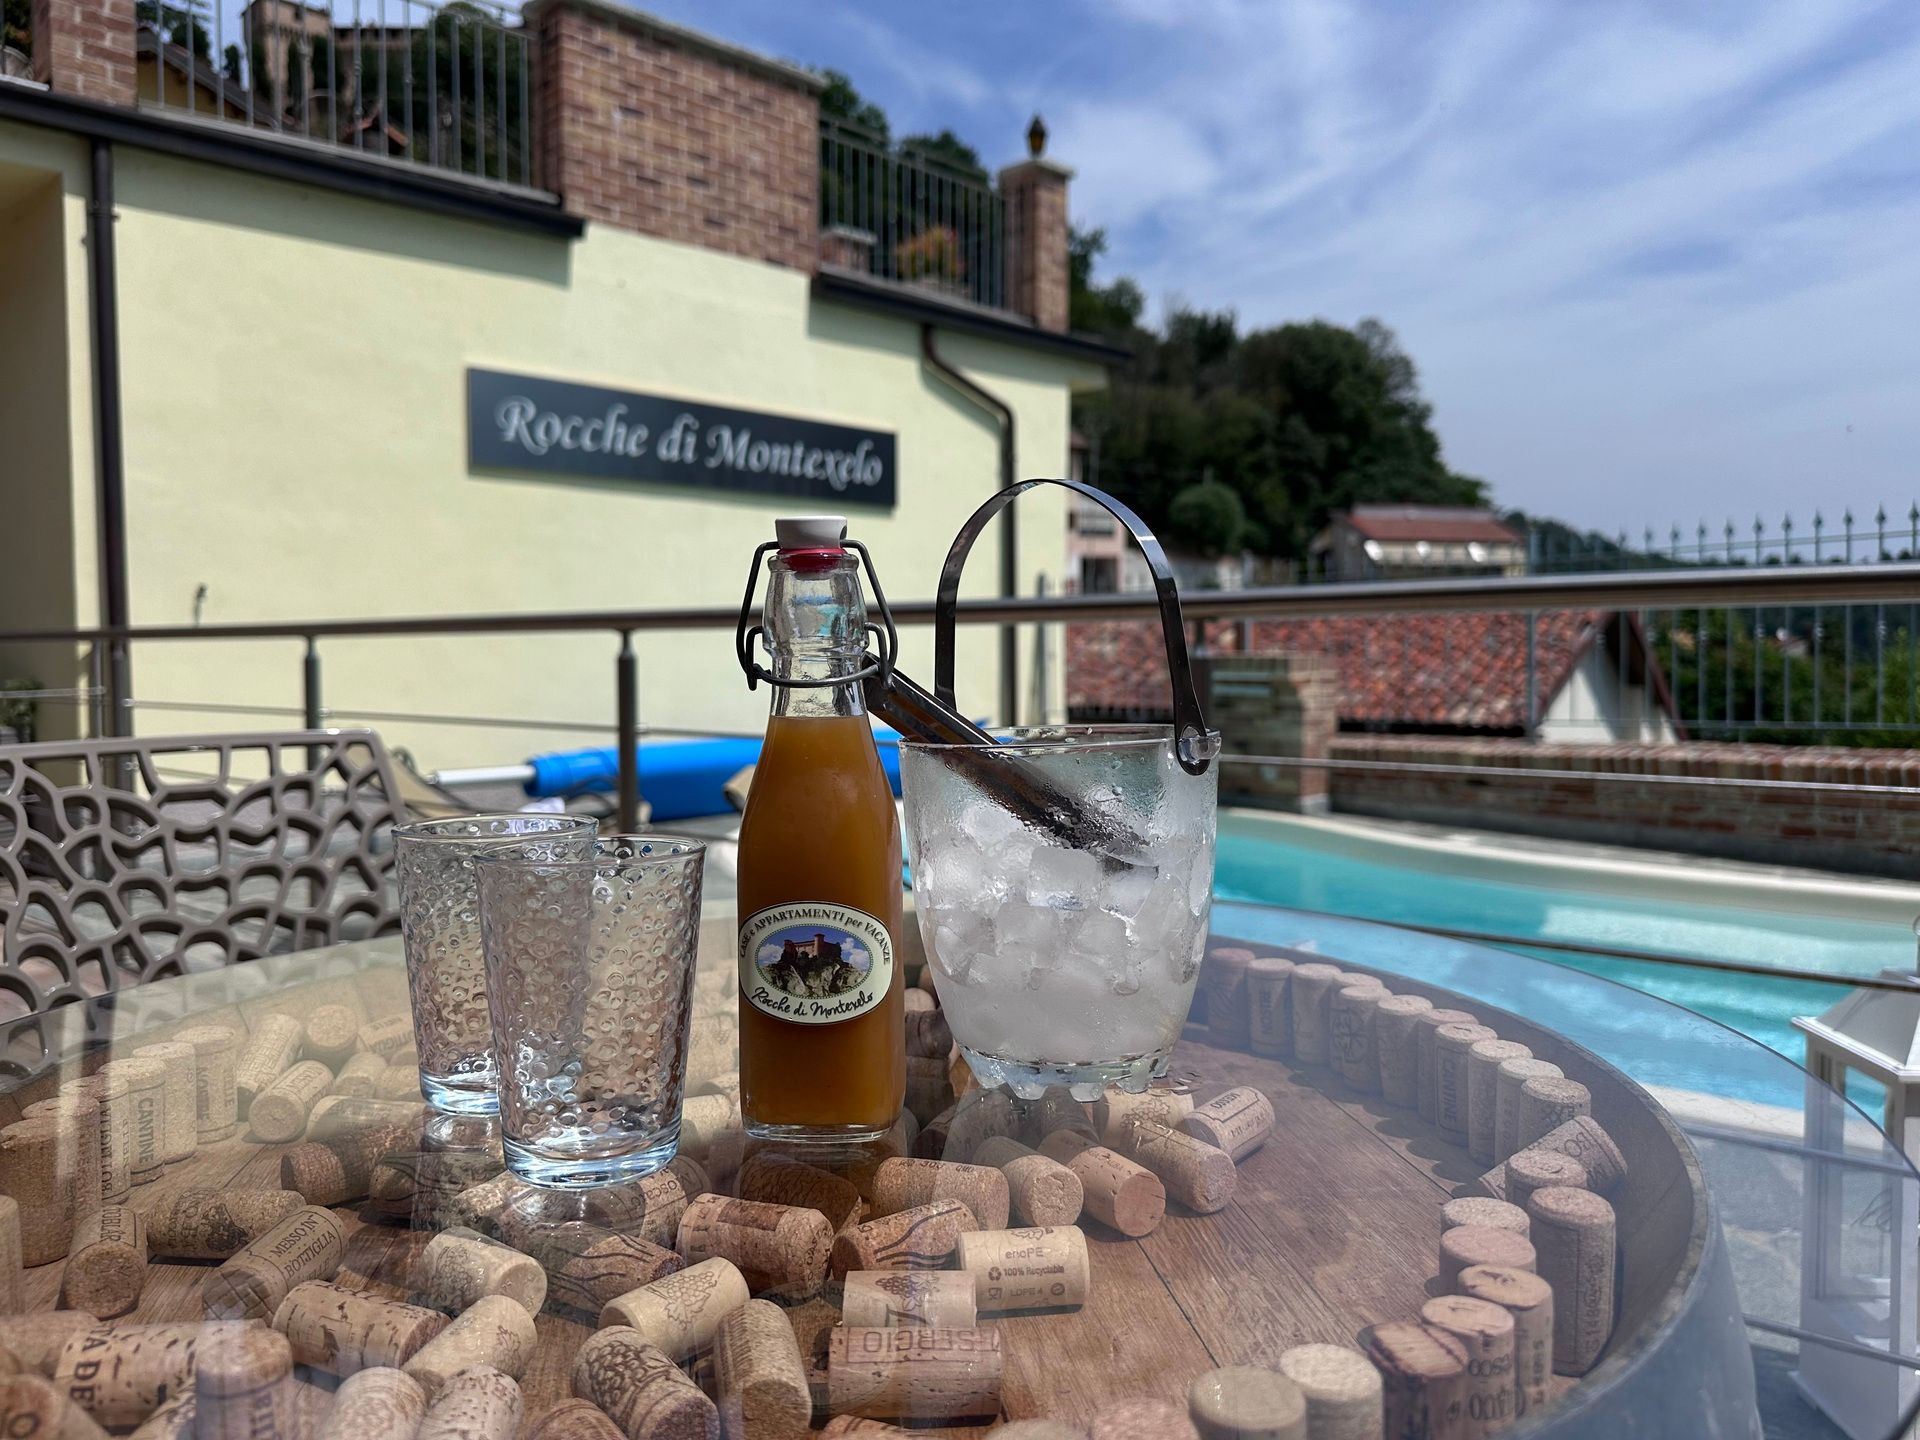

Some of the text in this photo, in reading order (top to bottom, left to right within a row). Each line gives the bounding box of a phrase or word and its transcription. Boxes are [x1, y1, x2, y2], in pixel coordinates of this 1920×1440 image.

[495, 395, 884, 491] Rocche di Montexelo
[740, 932, 751, 958] CASE
[754, 908, 845, 931] APPARTAMENTI
[846, 916, 863, 929] per
[865, 922, 891, 965] VACANZE
[751, 986, 874, 1018] Rocche di Montexelo
[137, 1097, 155, 1164] CANTINE
[271, 1227, 305, 1257] MESSO
[284, 1229, 337, 1280] BOTTIGLIA
